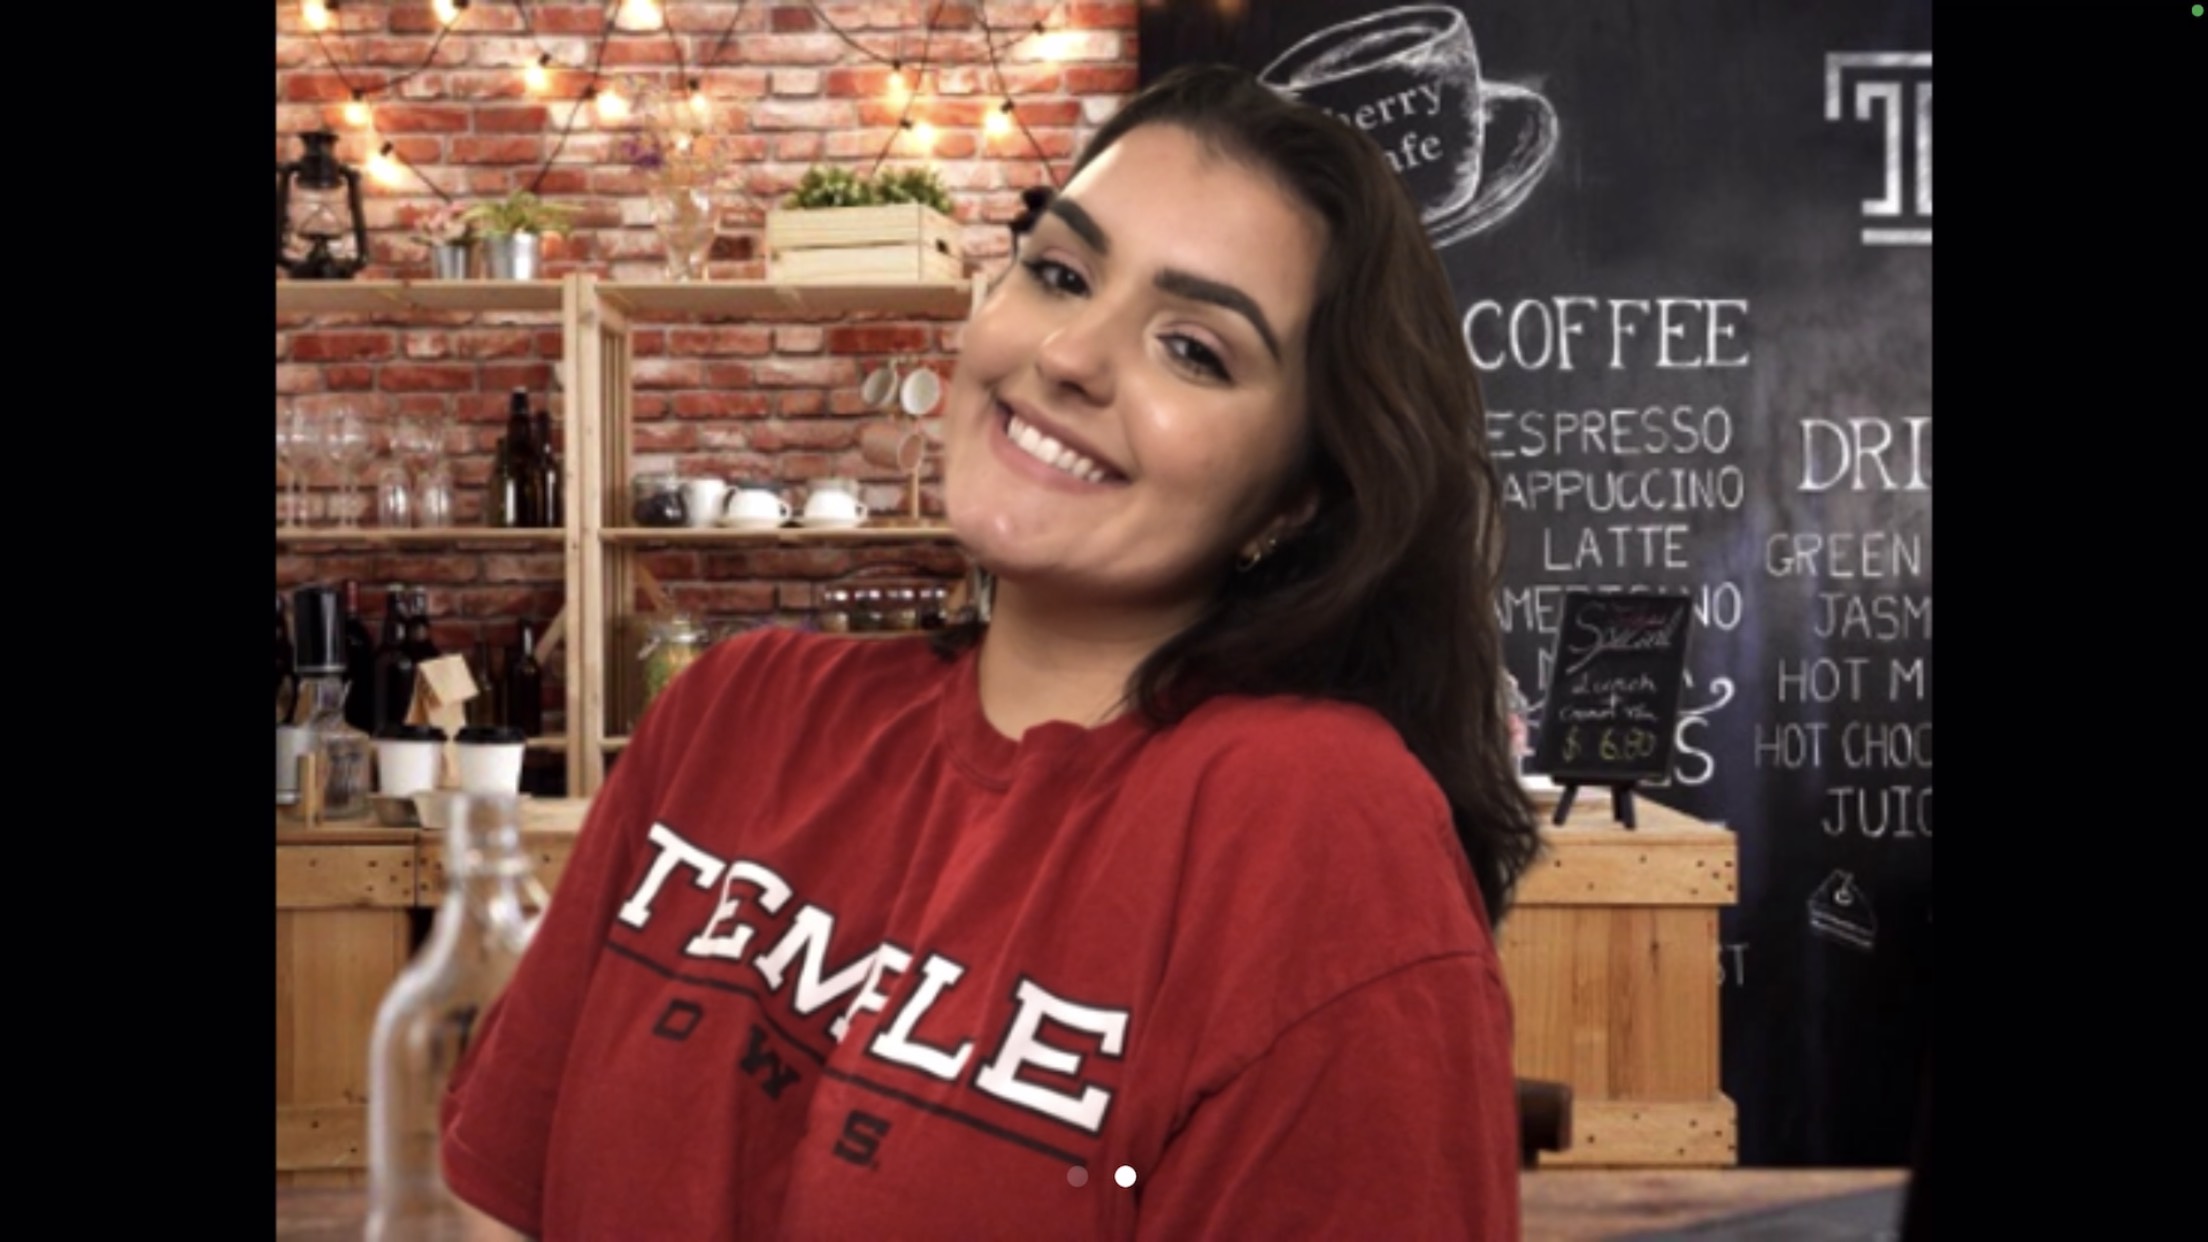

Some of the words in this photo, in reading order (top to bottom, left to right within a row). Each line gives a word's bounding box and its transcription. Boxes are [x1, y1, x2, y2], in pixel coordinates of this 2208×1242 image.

[1463, 297, 1749, 371] COFFEE
[1486, 406, 1733, 458] ESPRESSO
[1503, 465, 1745, 512] APPUCCINO
[1544, 524, 1690, 572] LATTE
[1766, 532, 1922, 579] GREEN
[1778, 658, 1869, 703] HOT
[1754, 723, 1828, 769] HOT
